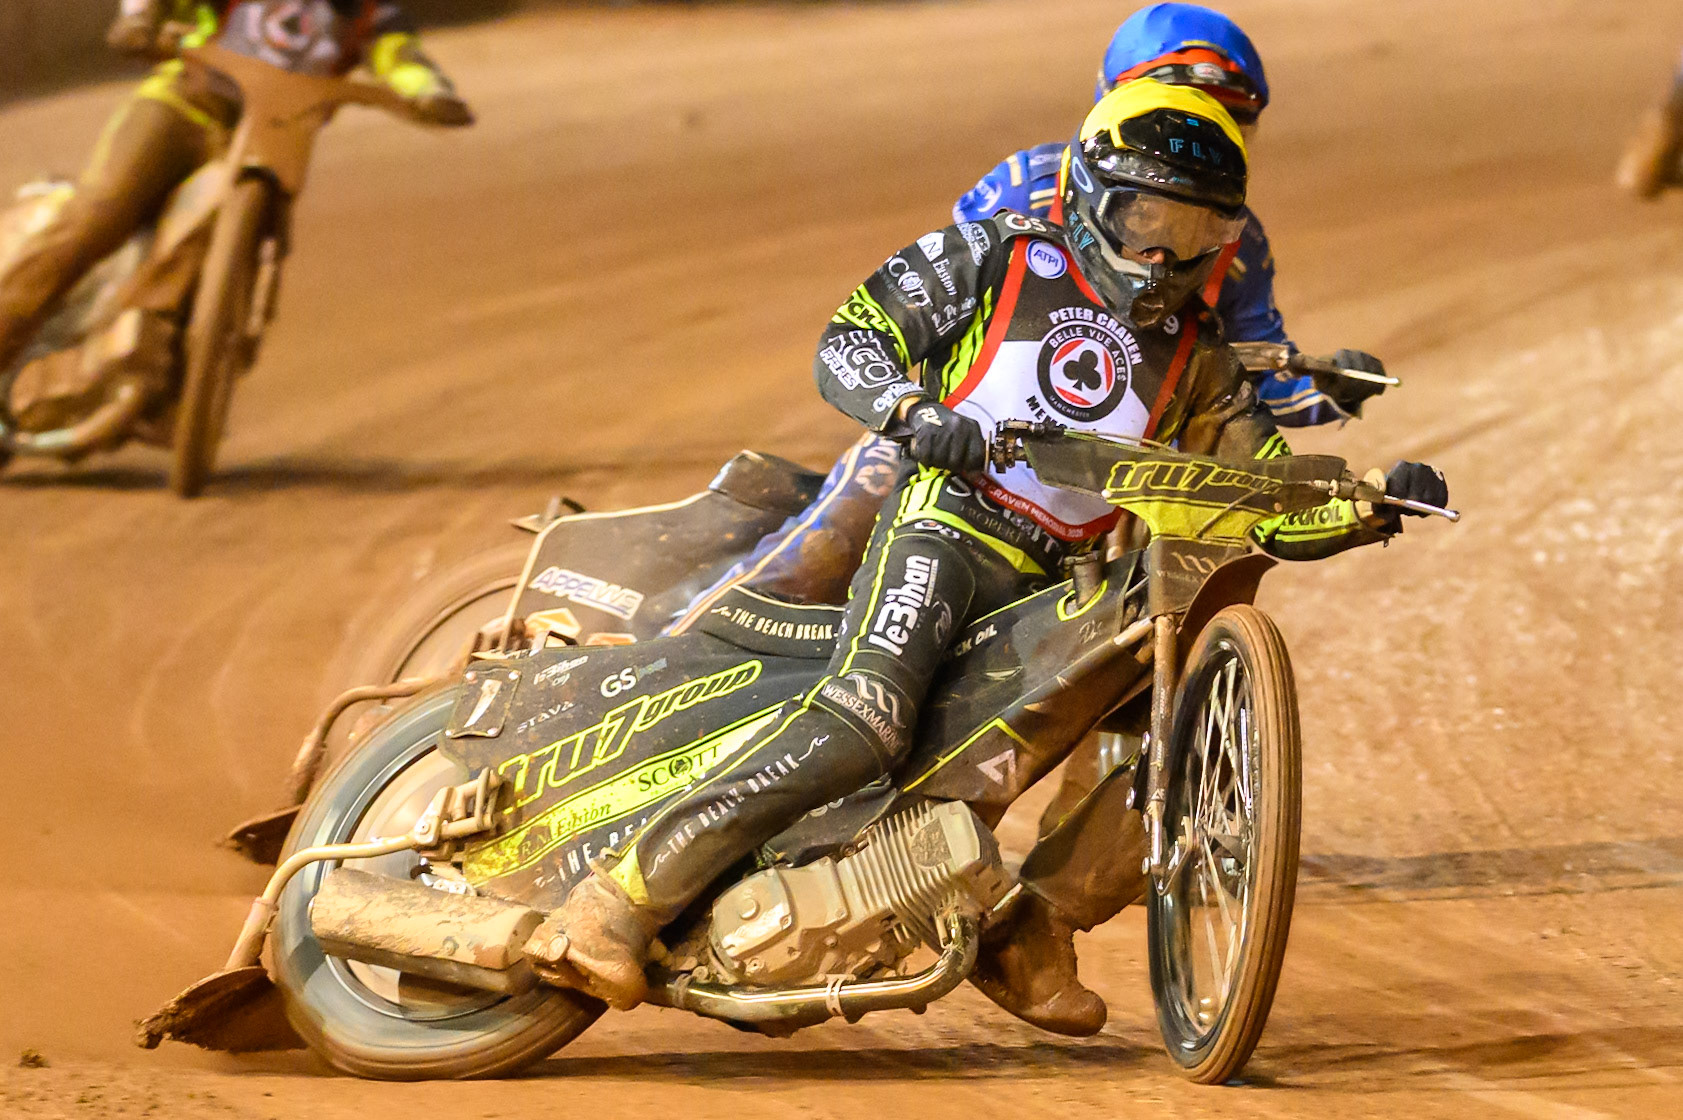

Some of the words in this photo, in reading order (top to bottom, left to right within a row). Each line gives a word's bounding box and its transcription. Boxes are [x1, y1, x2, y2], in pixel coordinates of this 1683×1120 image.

[1033, 249, 1059, 268] ATPI
[1048, 306, 1095, 325] PETER
[1096, 310, 1143, 366] CRAVEN
[1048, 326, 1084, 349] BELLE
[1088, 327, 1113, 348] VUE
[1112, 350, 1127, 382] ACES
[1316, 506, 1343, 525] OIL
[731, 608, 753, 627] THE
[757, 616, 793, 638] BEACH
[796, 624, 834, 641] BREAK
[975, 624, 998, 646] OIL
[600, 667, 637, 698] GS
[637, 742, 722, 794] SCOTT
[667, 823, 696, 855] THE
[698, 787, 746, 829] BEACH
[747, 752, 800, 795] BREAK
